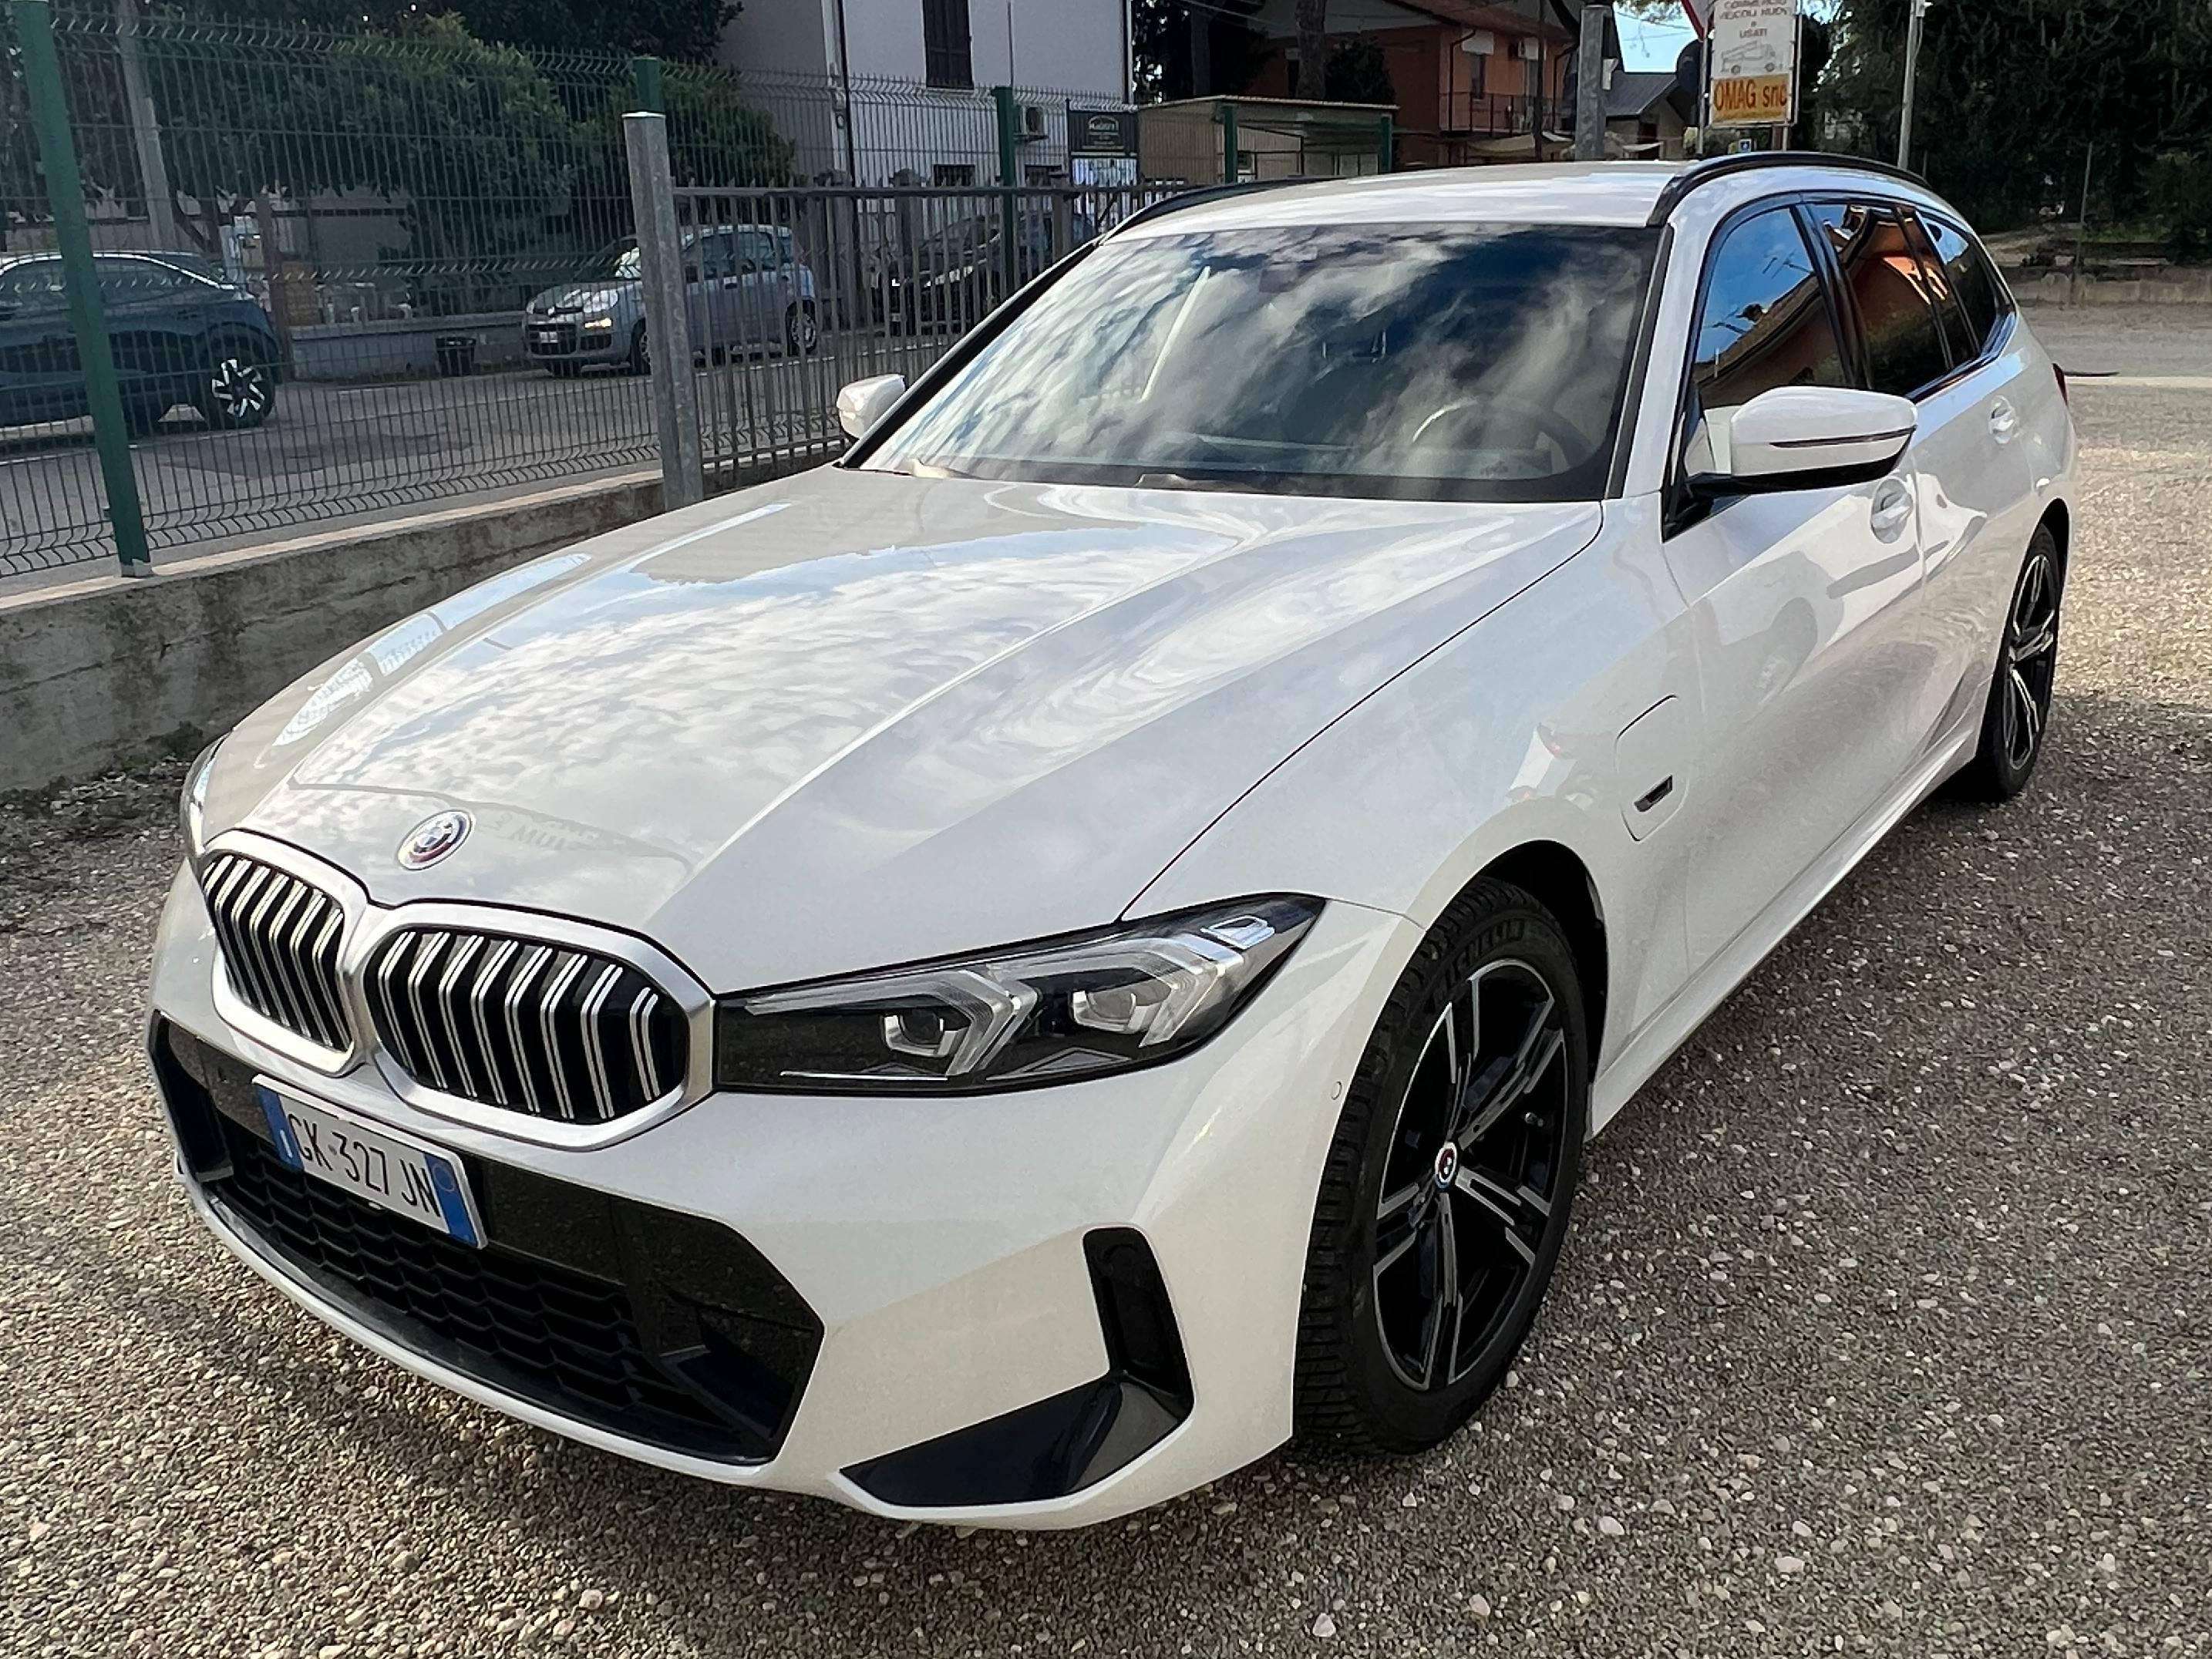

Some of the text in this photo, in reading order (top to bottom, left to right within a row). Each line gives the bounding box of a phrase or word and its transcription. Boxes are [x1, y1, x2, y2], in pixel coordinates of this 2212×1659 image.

[1739, 28, 1768, 38] USATI
[1714, 79, 1756, 111] OMAG
[332, 1132, 389, 1196] 327
[399, 1159, 441, 1217] JN
